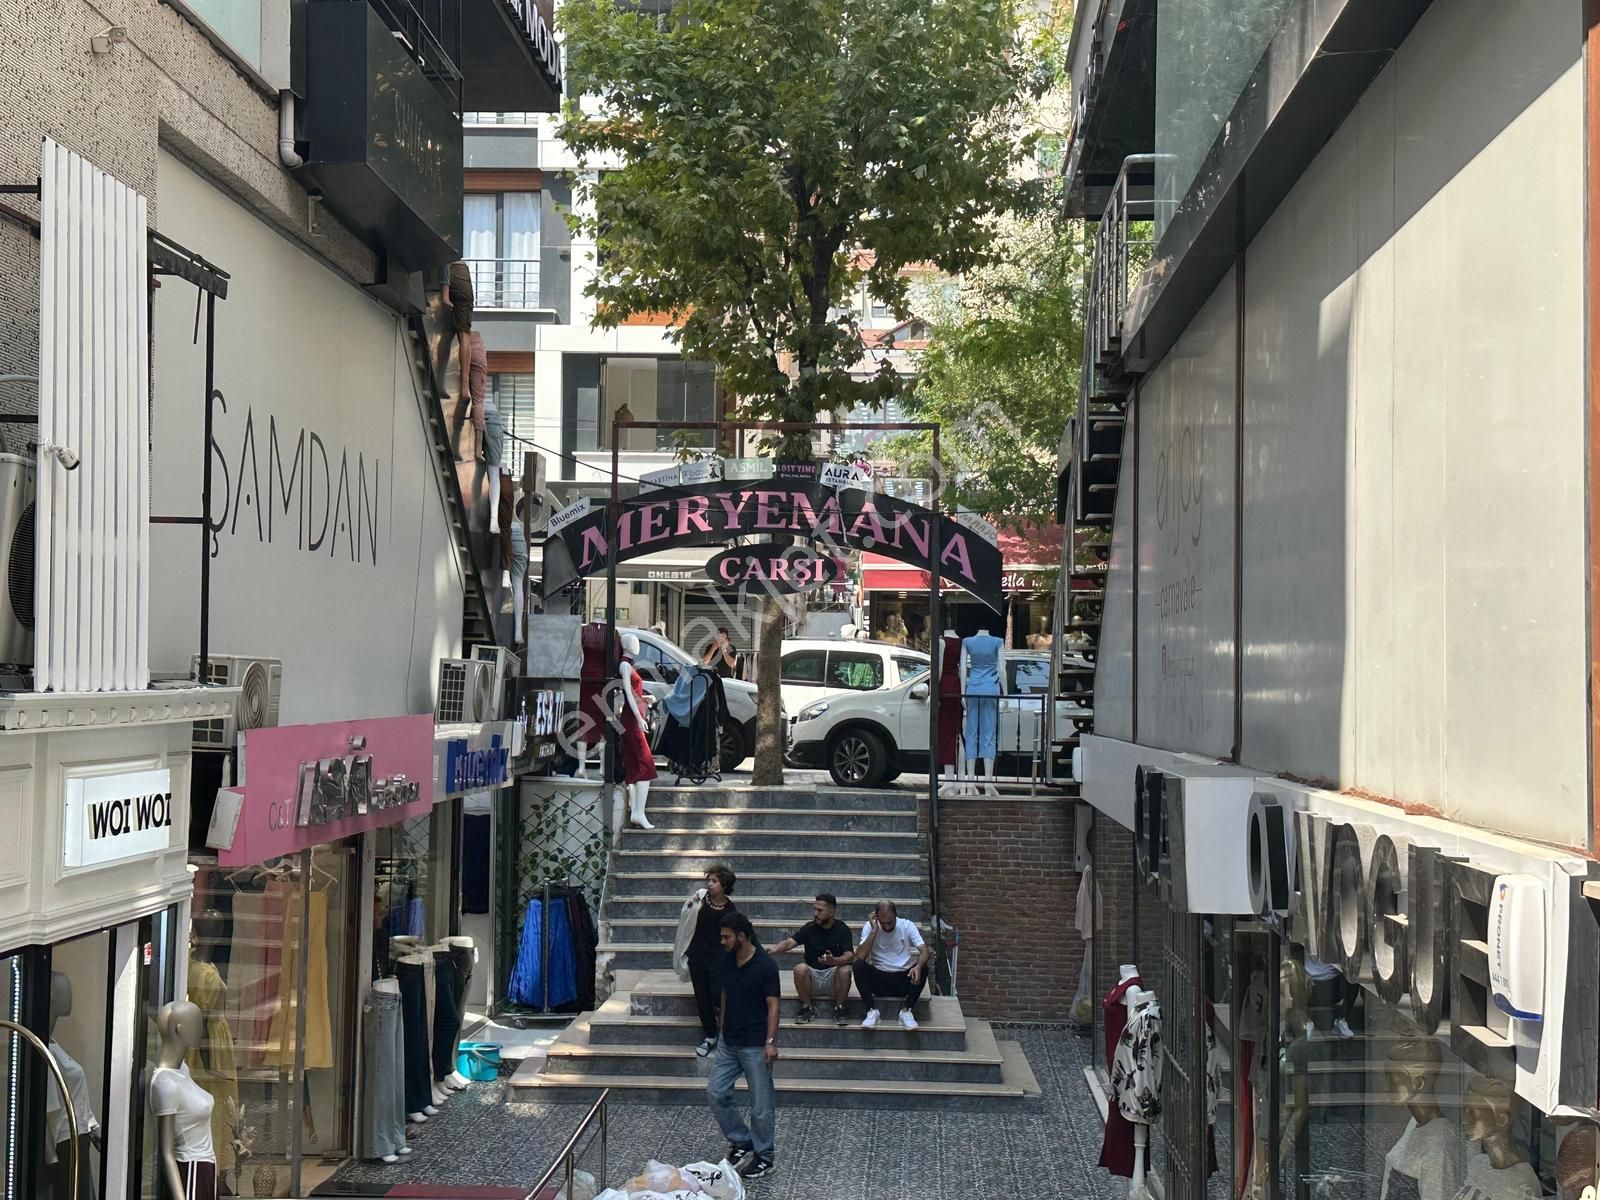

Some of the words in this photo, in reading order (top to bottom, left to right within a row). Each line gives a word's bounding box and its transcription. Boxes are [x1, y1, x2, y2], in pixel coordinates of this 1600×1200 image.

[824, 467, 860, 482] AURA
[550, 502, 587, 528] Bluemix
[578, 490, 977, 583] MERYEMANA
[718, 556, 825, 587] ÇARŞI
[91, 798, 131, 840] WOI
[135, 792, 171, 831] WOI
